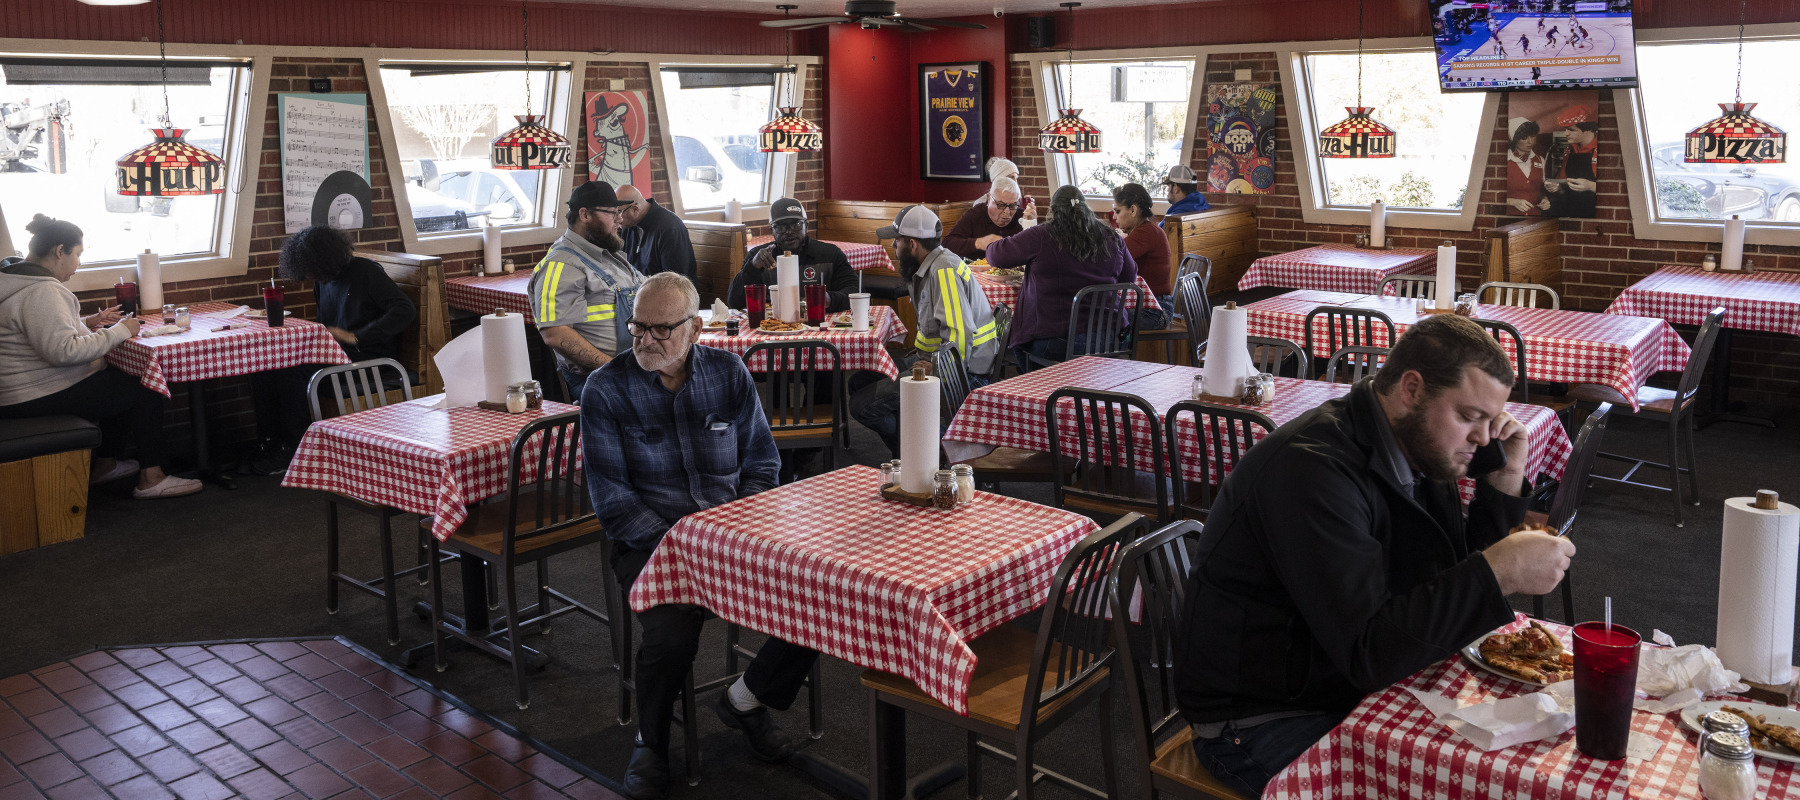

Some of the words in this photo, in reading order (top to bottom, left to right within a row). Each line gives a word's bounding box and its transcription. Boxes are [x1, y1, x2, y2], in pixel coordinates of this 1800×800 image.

[931, 97, 958, 109] PRAIRIE
[958, 97, 975, 109] VIEW
[772, 129, 820, 152] Pizza
[1224, 134, 1255, 145] BOOK
[1233, 143, 1247, 153] IT!
[1344, 132, 1390, 158] Hut
[1698, 132, 1777, 163] Pizza
[130, 161, 198, 196] Hut
